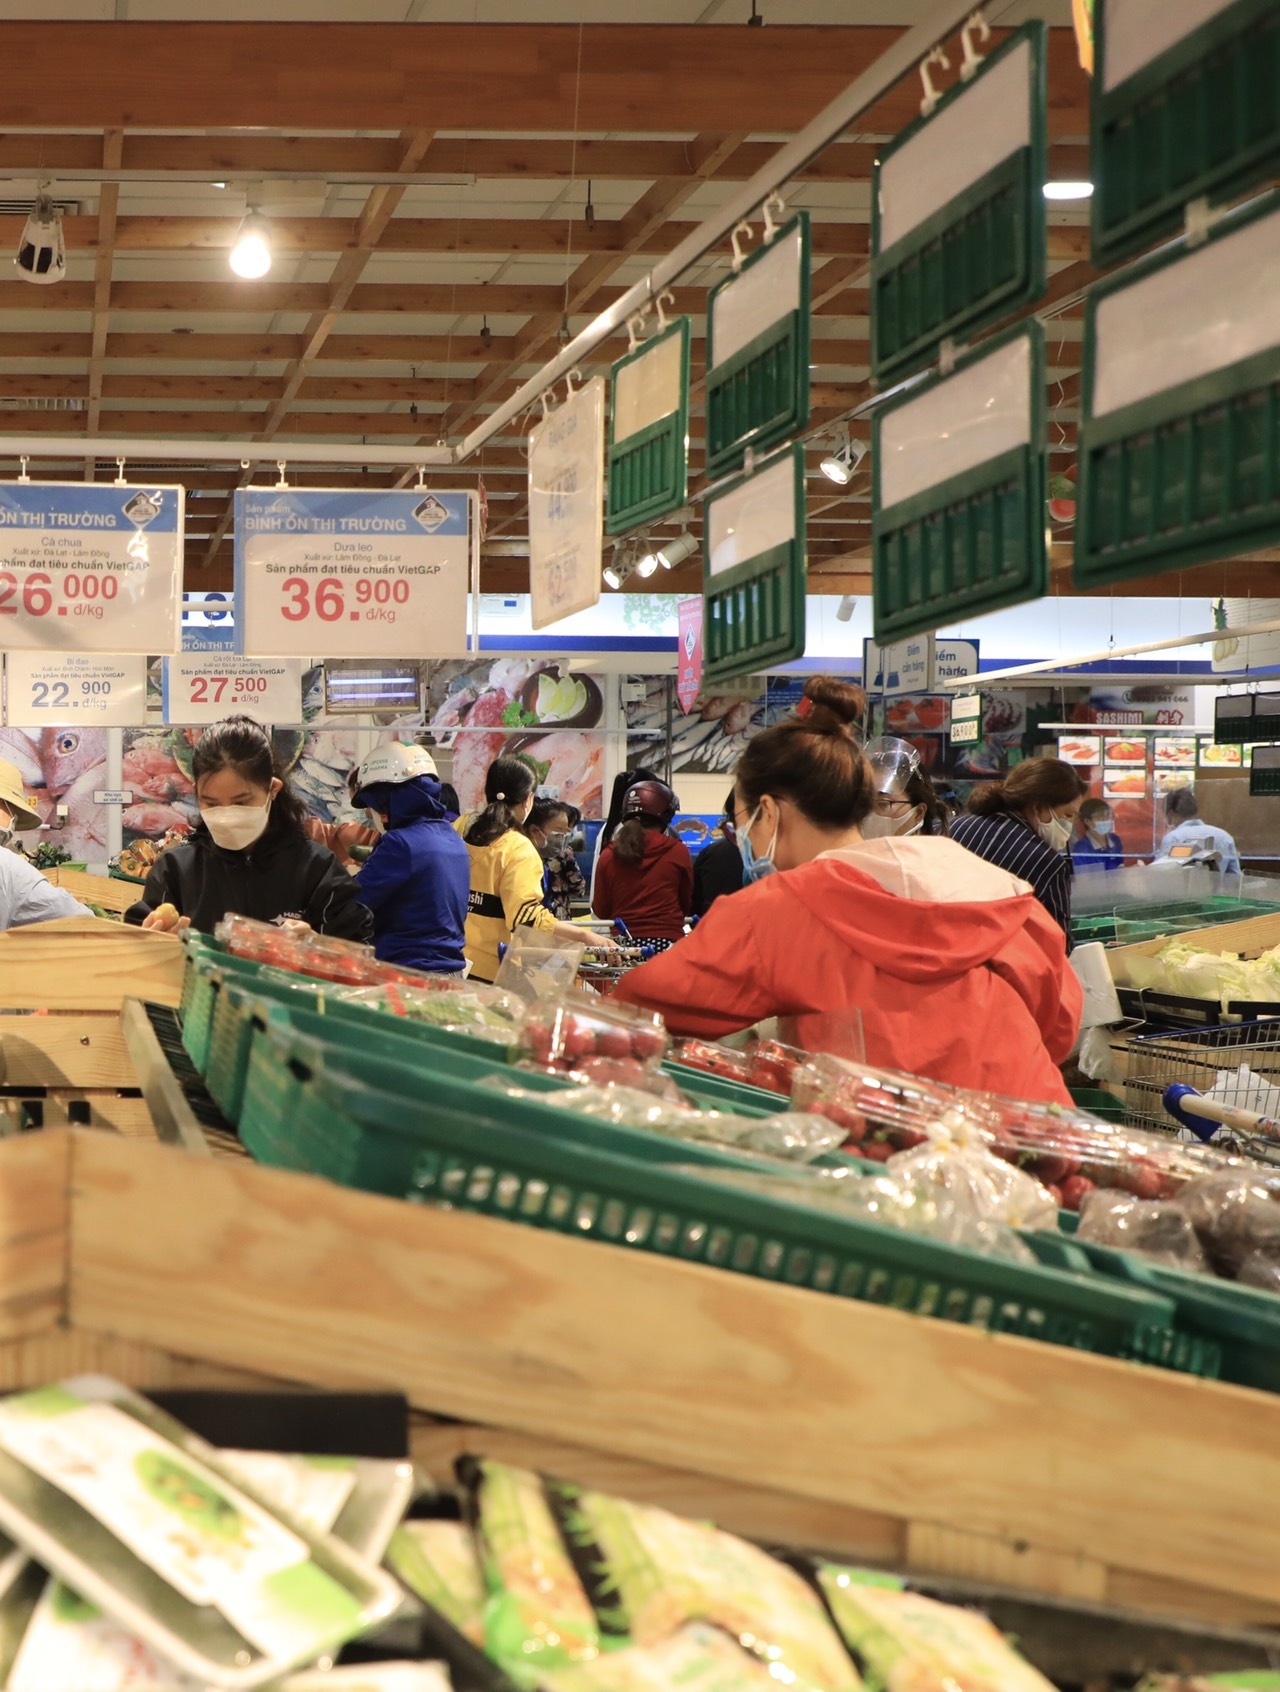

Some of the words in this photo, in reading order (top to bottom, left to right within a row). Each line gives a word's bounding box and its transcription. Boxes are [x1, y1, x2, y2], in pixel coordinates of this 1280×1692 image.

[20, 511, 45, 528] THỊ
[49, 510, 116, 528] TRƯỜNG
[244, 515, 281, 531] BÌNH
[285, 513, 308, 531] ỔN
[311, 518, 336, 534] THỊ
[339, 516, 407, 532] TRƯỜNG
[57, 537, 82, 548] chua
[334, 541, 356, 552] Dưa
[358, 541, 373, 552] leo
[28, 560, 46, 570] đạt
[48, 560, 67, 569] tiêu
[71, 558, 104, 570] chuẩn
[106, 561, 150, 572] VietGAP
[266, 564, 286, 574] Sản
[289, 563, 318, 576] phẩm
[321, 564, 338, 577] đạt
[340, 564, 360, 575] tiêu
[363, 562, 395, 575] chuẩn
[398, 564, 441, 575] VietGAP
[935, 649, 956, 661] iểm
[1096, 712, 1142, 724] SASHIMI
